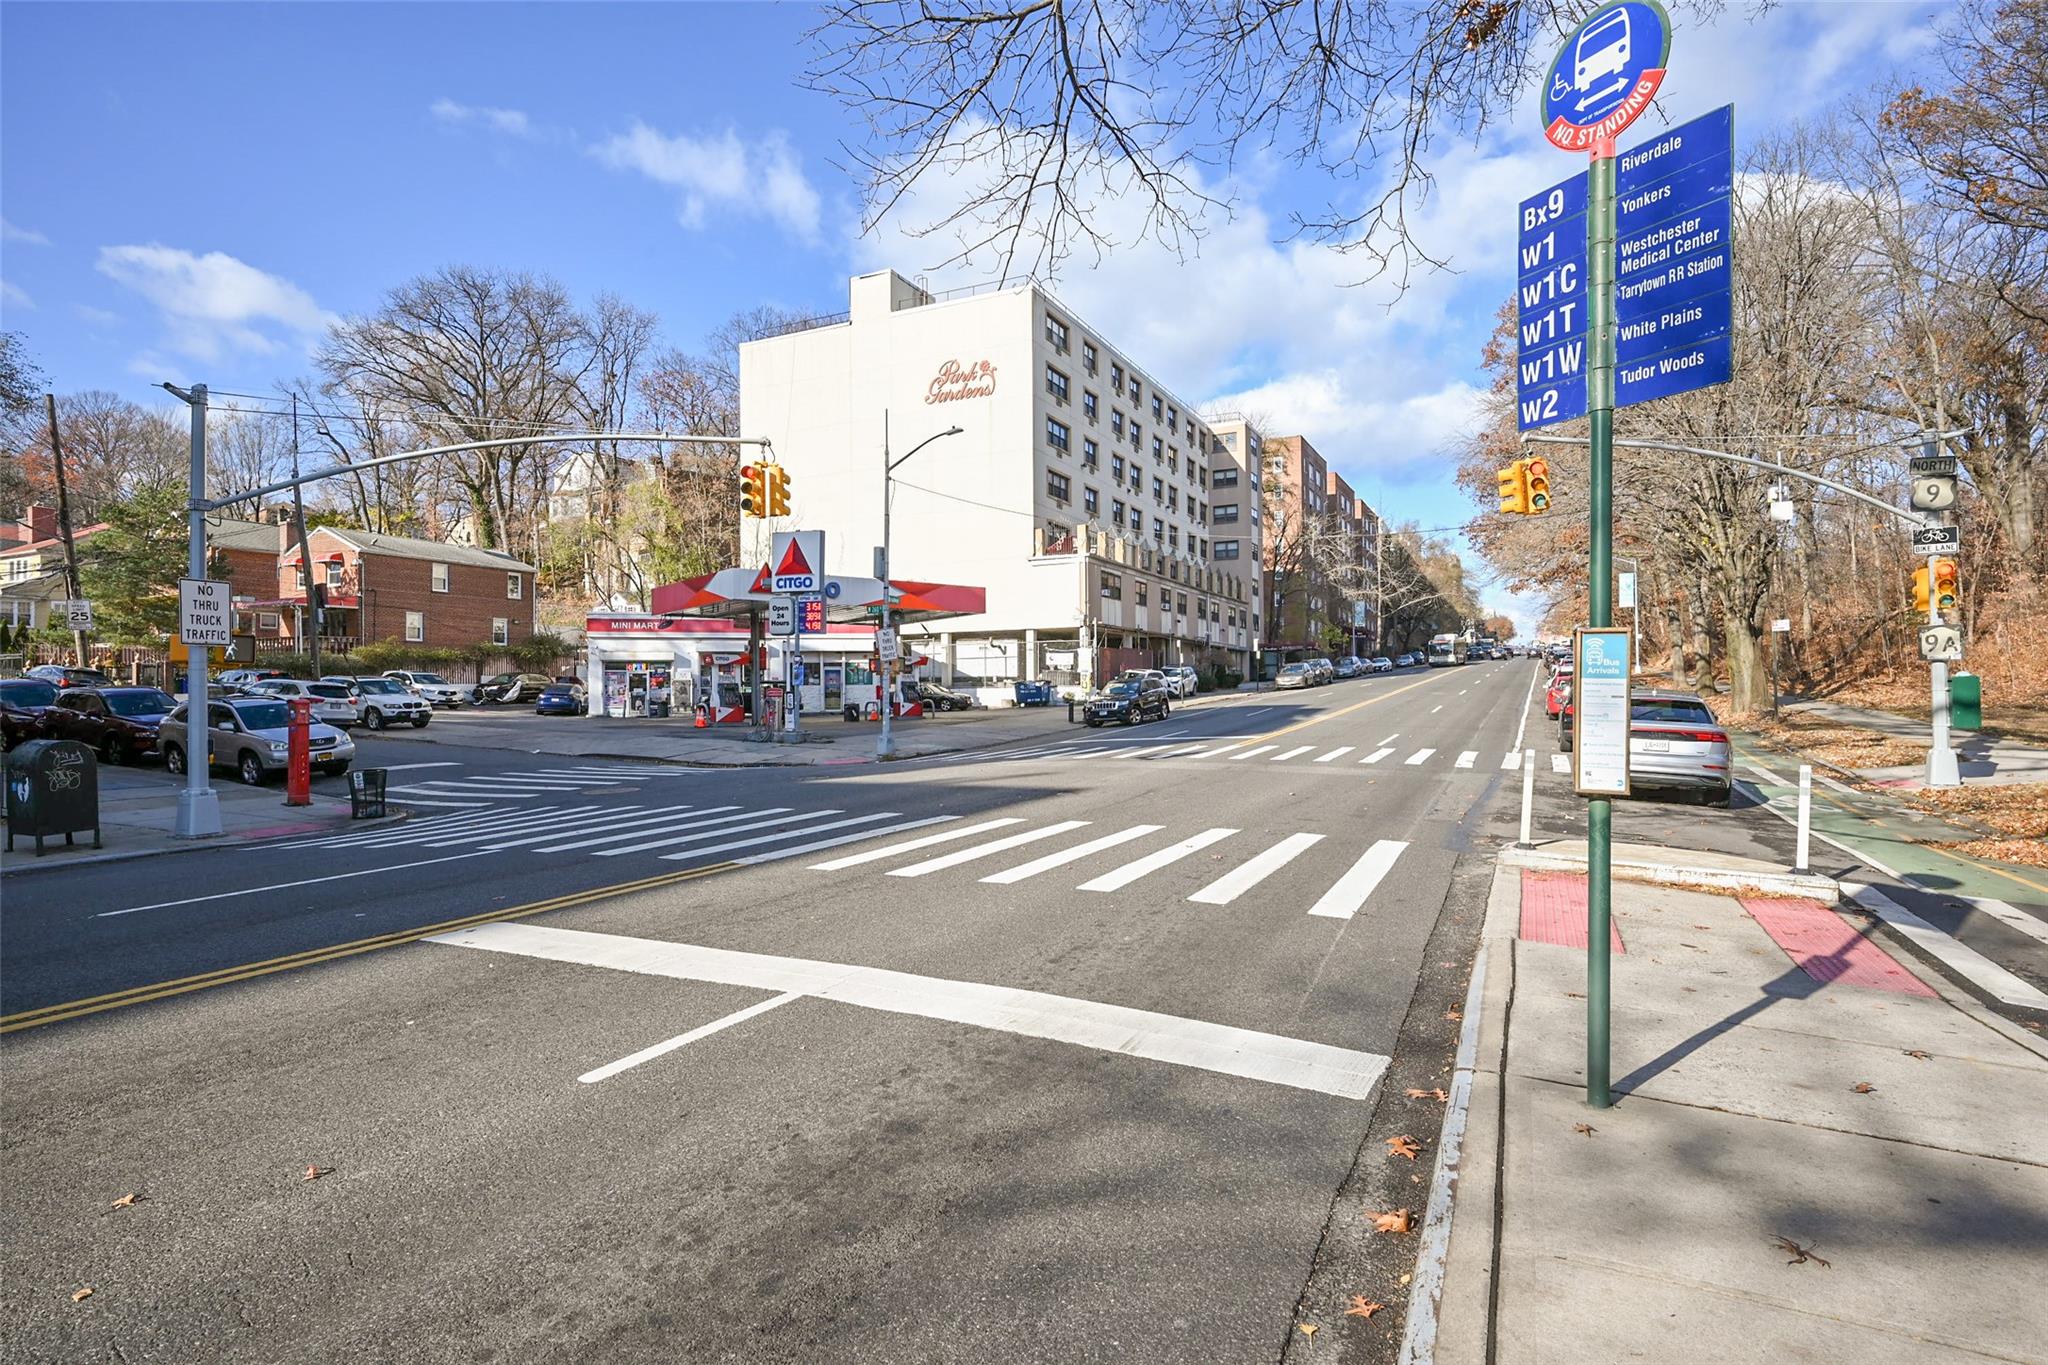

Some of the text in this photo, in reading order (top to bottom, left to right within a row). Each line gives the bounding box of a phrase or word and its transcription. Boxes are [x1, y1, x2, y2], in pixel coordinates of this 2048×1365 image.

[1553, 80, 1653, 146] NO STANDING
[1621, 136, 1682, 173] Riverdale
[1524, 189, 1564, 232] Bx9
[1621, 185, 1672, 215] Yonkers
[1522, 232, 1555, 270] W1
[1620, 217, 1701, 257] Westchester
[1621, 228, 1720, 275] Medical Center
[1522, 263, 1577, 308] W1C
[1620, 254, 1723, 300] Tarrytown RR Station
[1522, 302, 1576, 347] W1T
[1621, 307, 1703, 342] White Plains
[939, 360, 978, 389] Park
[1521, 341, 1582, 386] W1W
[1620, 351, 1705, 385] Tudor Woods
[925, 377, 995, 405] Gardens
[1521, 389, 1558, 424] W2
[1912, 461, 1952, 472] NORTH
[1927, 484, 1940, 503] 9
[1915, 543, 1955, 553] BIKE LANE
[198, 585, 214, 596] NO
[776, 577, 813, 589] CITGO
[70, 611, 89, 621] 25
[190, 614, 222, 626] TRUCK
[193, 600, 219, 611] THRU
[186, 628, 226, 641] TRAFFIC
[1586, 667, 1620, 675] Arrivals
[1603, 658, 1620, 666] Bus
